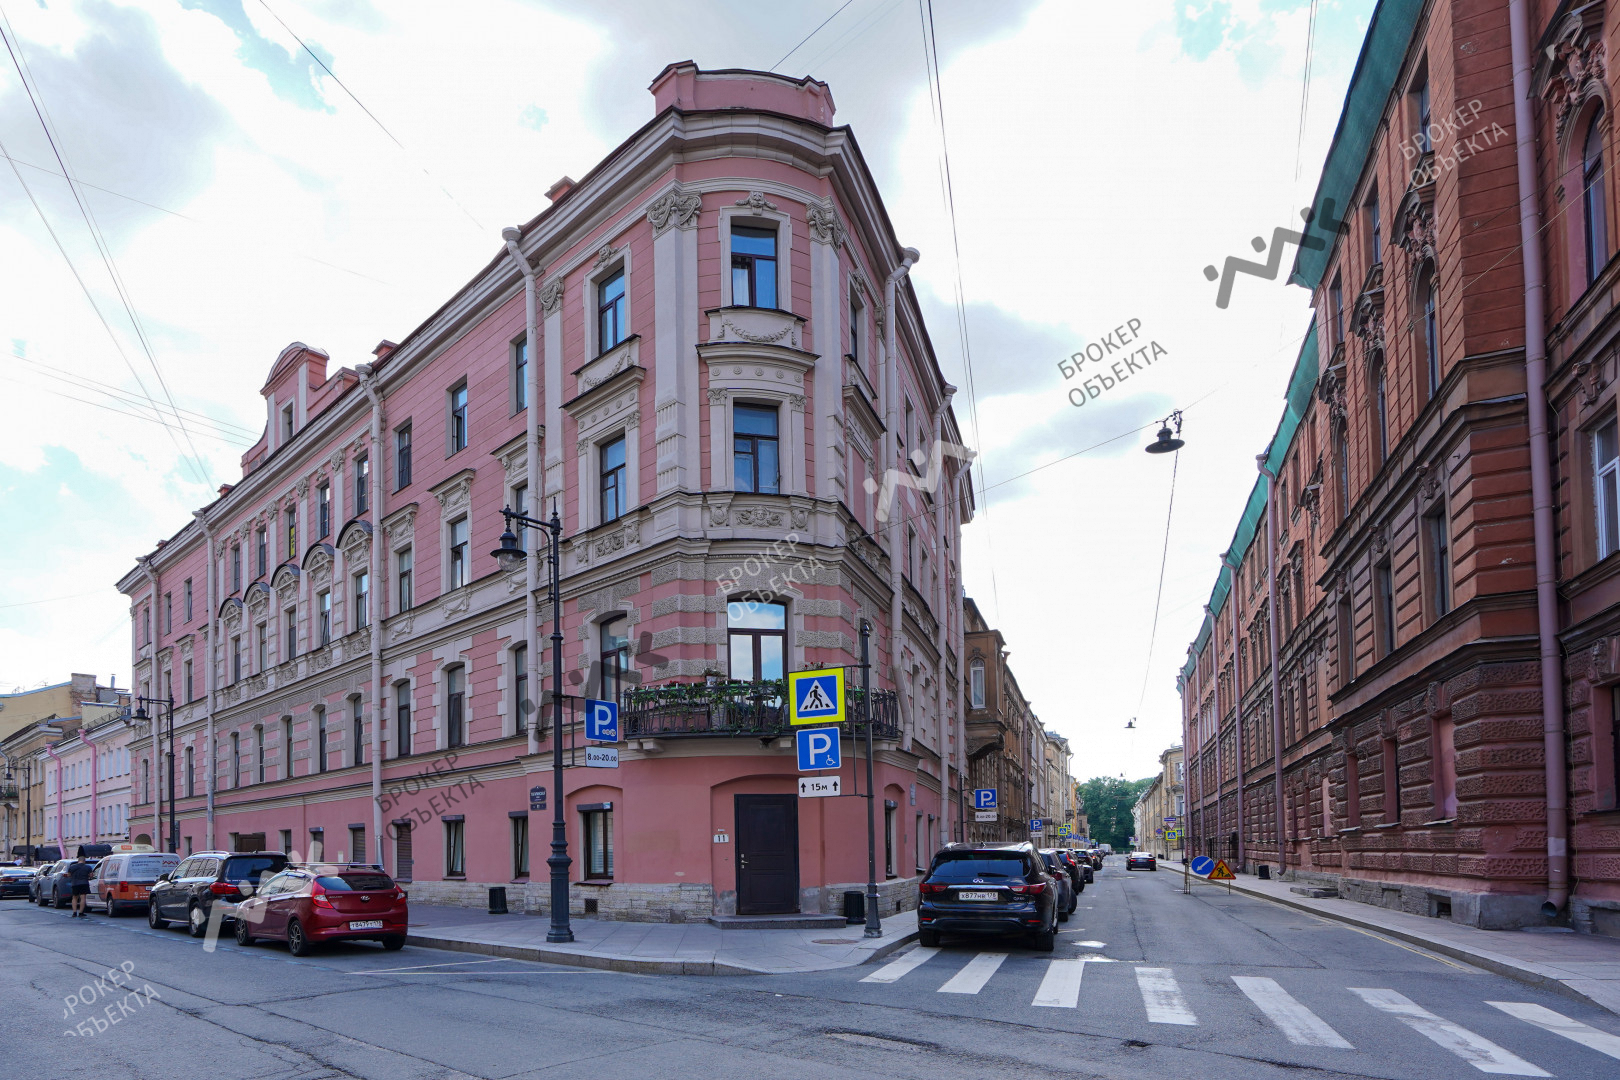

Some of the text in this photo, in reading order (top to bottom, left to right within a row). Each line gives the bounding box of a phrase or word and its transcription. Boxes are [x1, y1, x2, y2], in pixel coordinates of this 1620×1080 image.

[594, 704, 612, 736] P
[808, 733, 832, 766] P
[981, 791, 993, 806] P
